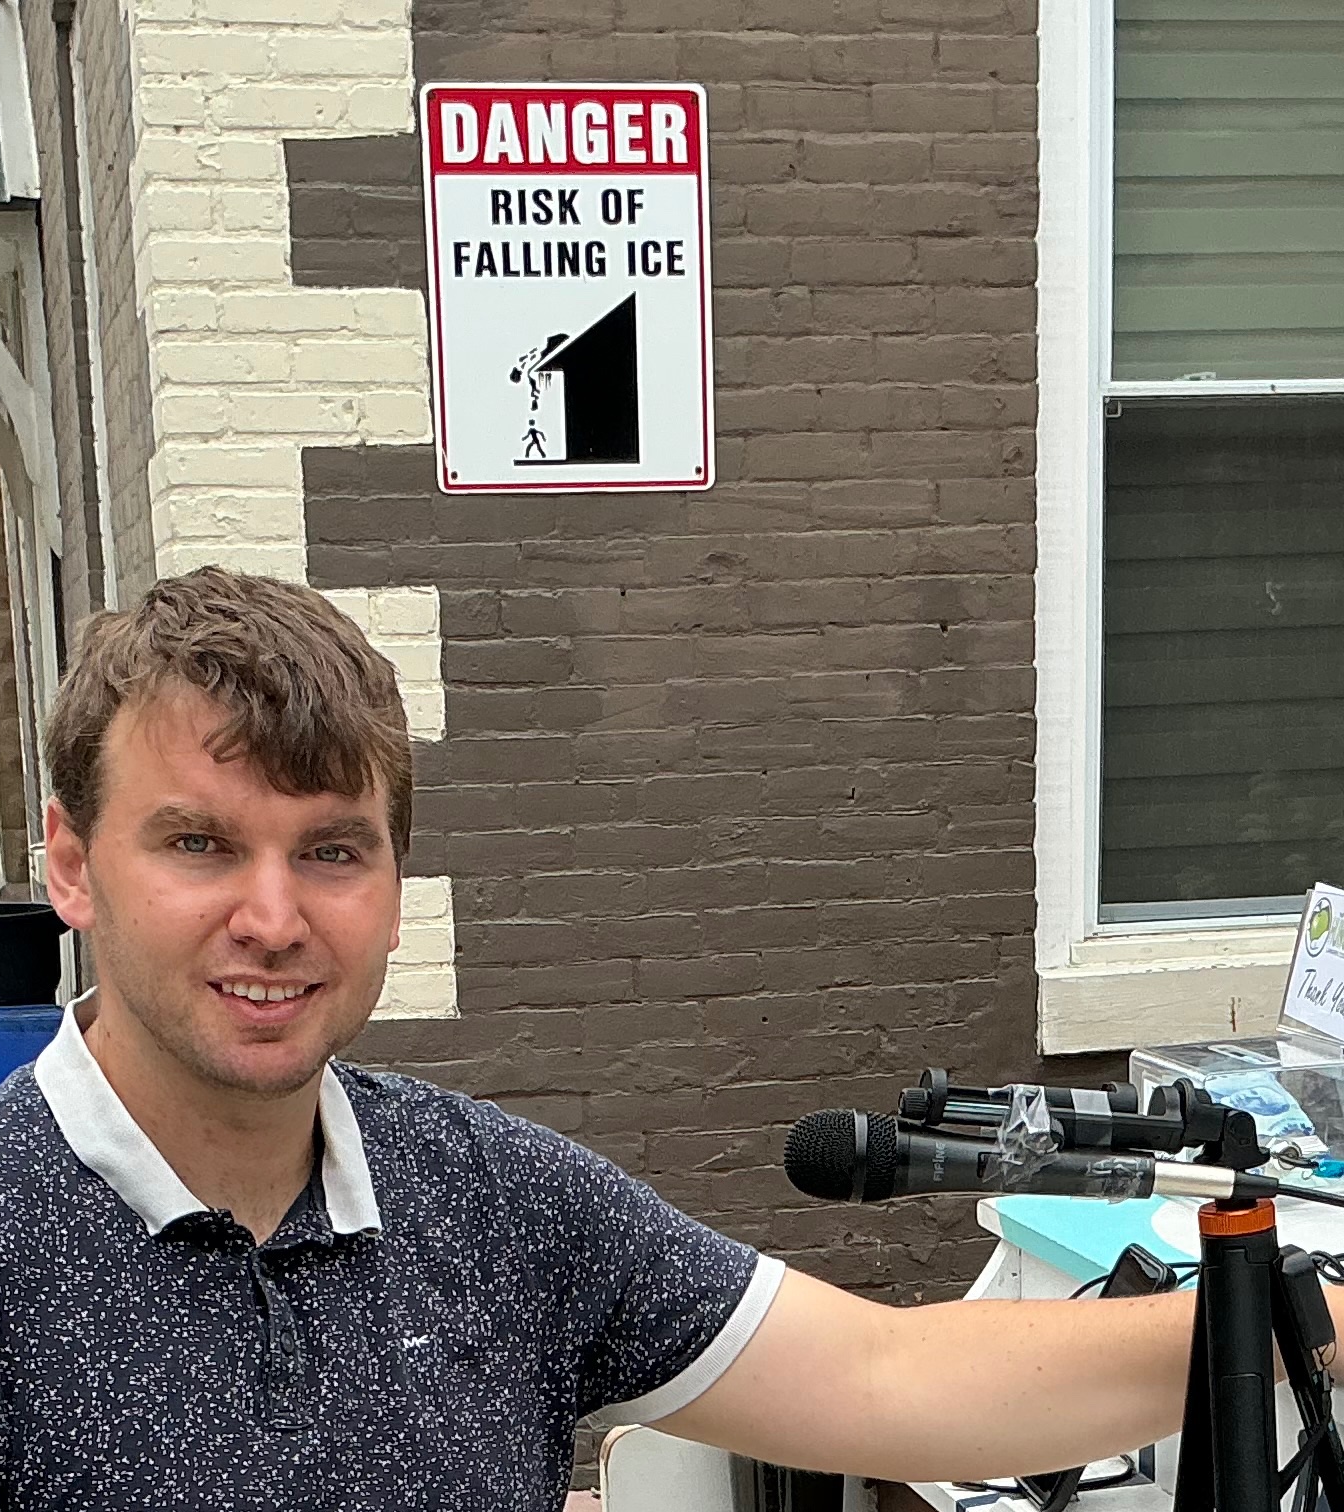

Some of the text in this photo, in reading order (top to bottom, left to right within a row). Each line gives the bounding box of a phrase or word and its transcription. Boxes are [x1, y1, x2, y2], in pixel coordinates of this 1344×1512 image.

[440, 101, 689, 165] DANGER
[490, 188, 644, 226] RISK OF
[452, 239, 686, 278] FALLING ICE
[1297, 968, 1335, 1006] Thank
